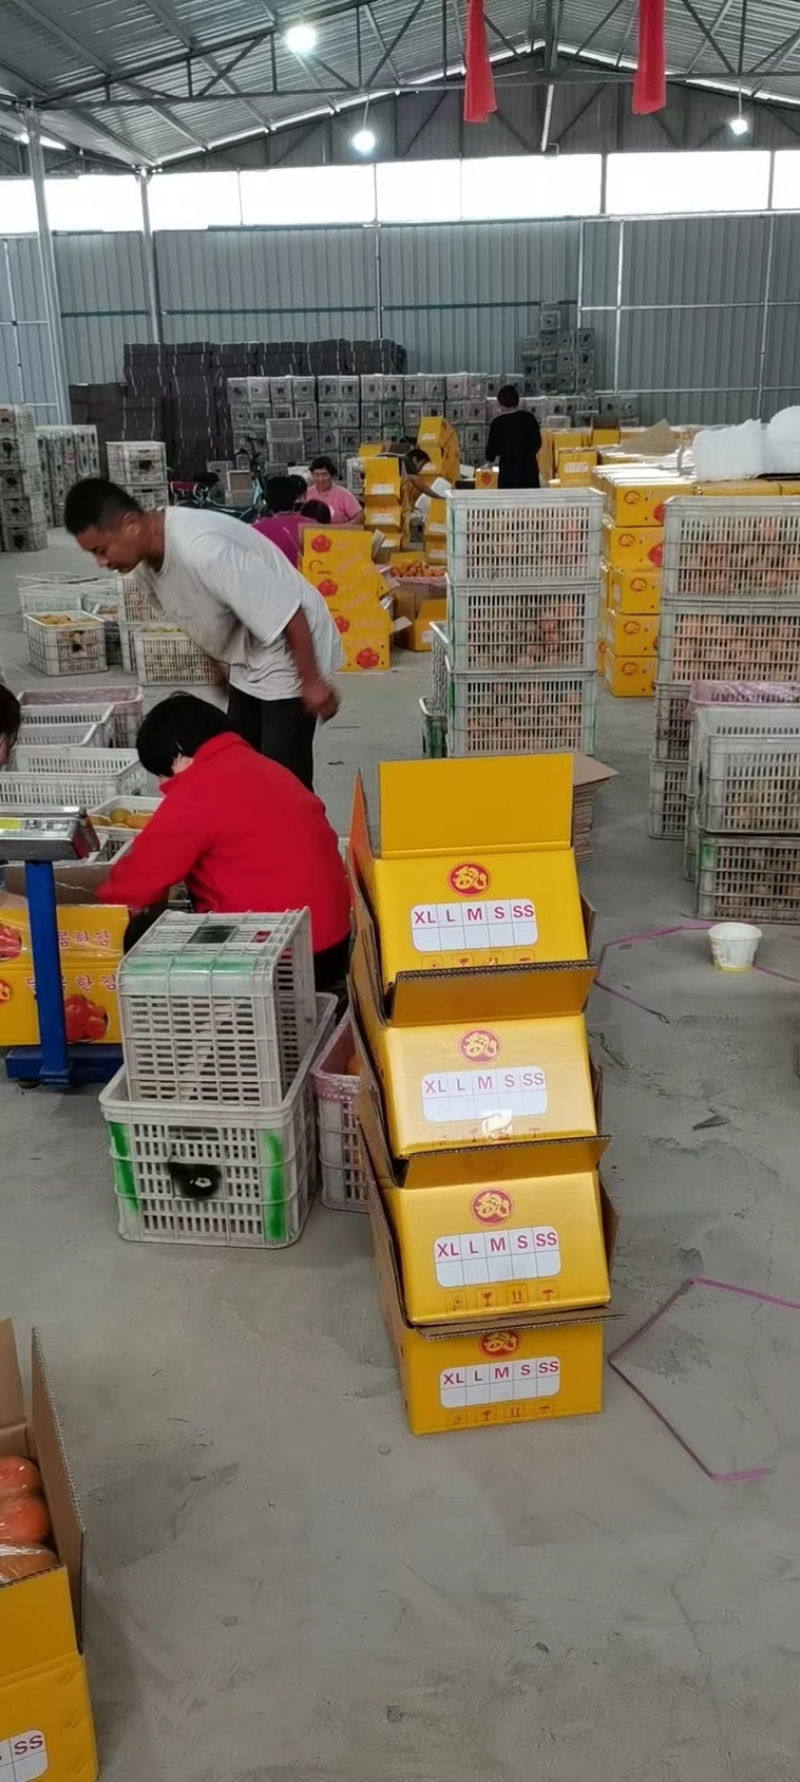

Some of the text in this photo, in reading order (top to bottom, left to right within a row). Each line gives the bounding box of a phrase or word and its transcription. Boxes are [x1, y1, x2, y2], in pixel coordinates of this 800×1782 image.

[414, 904, 534, 924] XL L M S SS
[425, 1072, 544, 1094] XL L M S SS
[437, 1232, 557, 1257] XL L M S SS
[443, 1361, 559, 1385] XL L M S SS
[14, 1734, 43, 1755] SS
